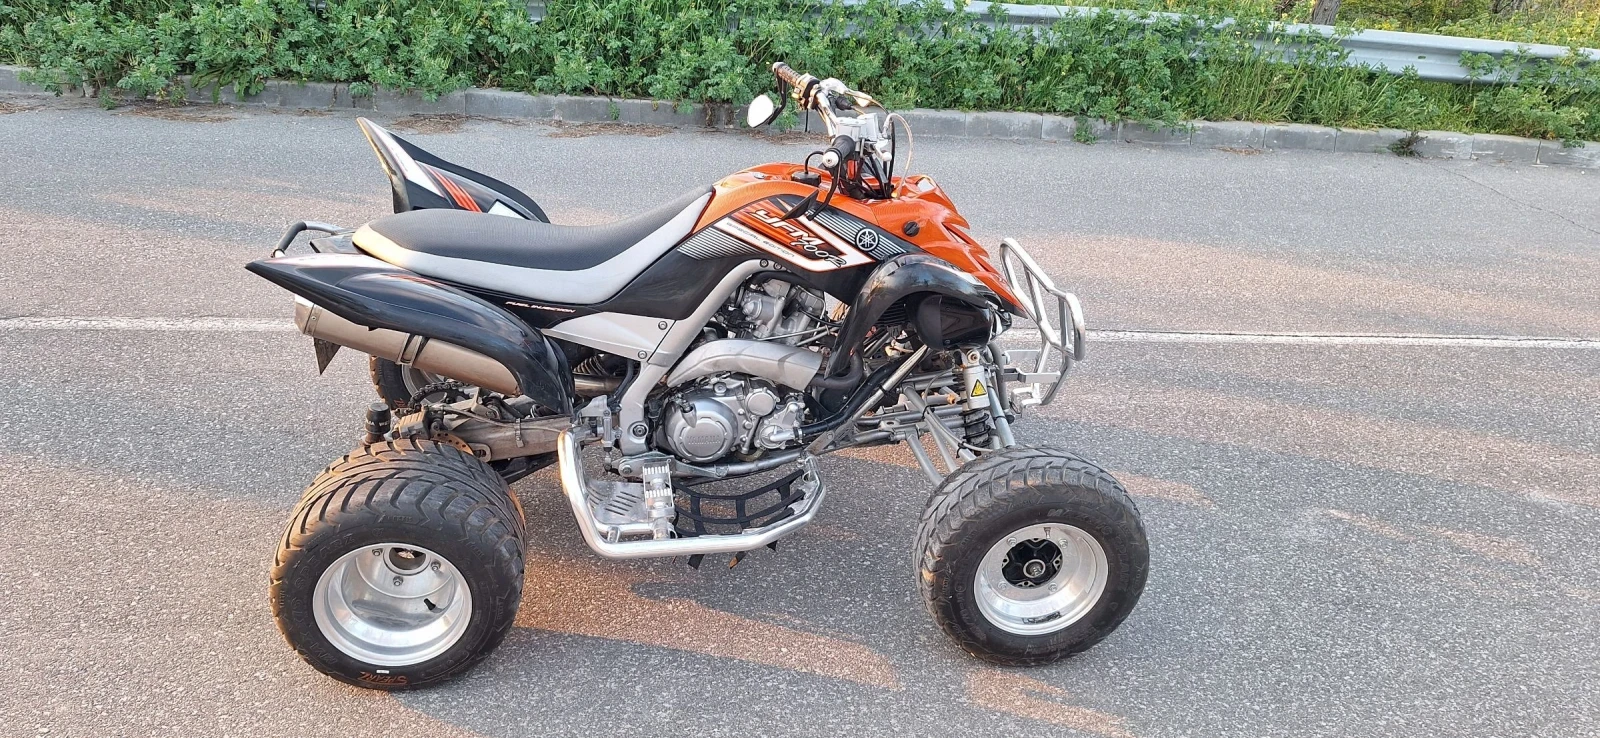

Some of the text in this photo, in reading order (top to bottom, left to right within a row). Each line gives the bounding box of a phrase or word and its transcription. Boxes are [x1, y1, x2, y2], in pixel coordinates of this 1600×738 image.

[748, 209, 826, 246] YFM
[762, 238, 796, 258] EDITION
[791, 239, 848, 268] 700R
[358, 671, 408, 685] SPEARZ
